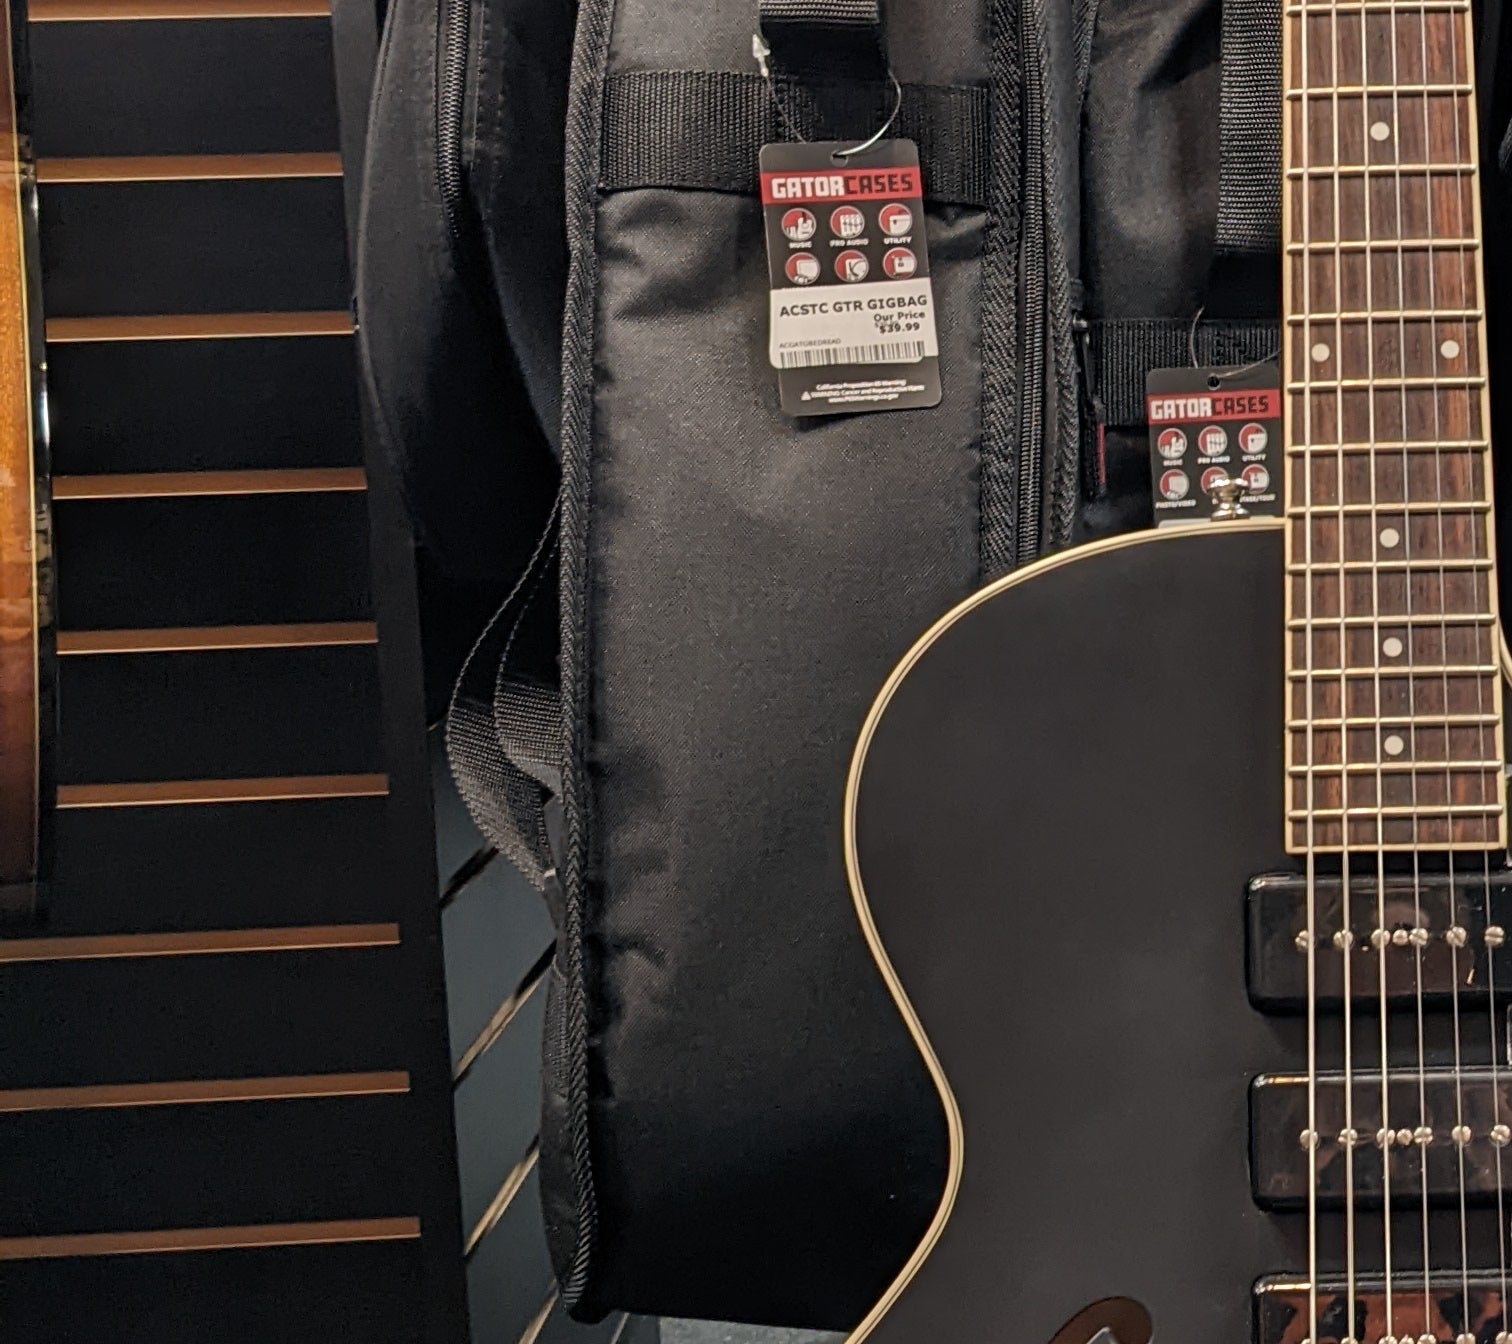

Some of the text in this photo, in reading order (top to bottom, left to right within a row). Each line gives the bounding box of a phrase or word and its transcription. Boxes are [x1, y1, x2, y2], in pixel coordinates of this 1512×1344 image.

[779, 295, 928, 318] ACSTC GTR GIGBAG
[874, 311, 926, 323] Our Price
[879, 322, 921, 335] $39.99
